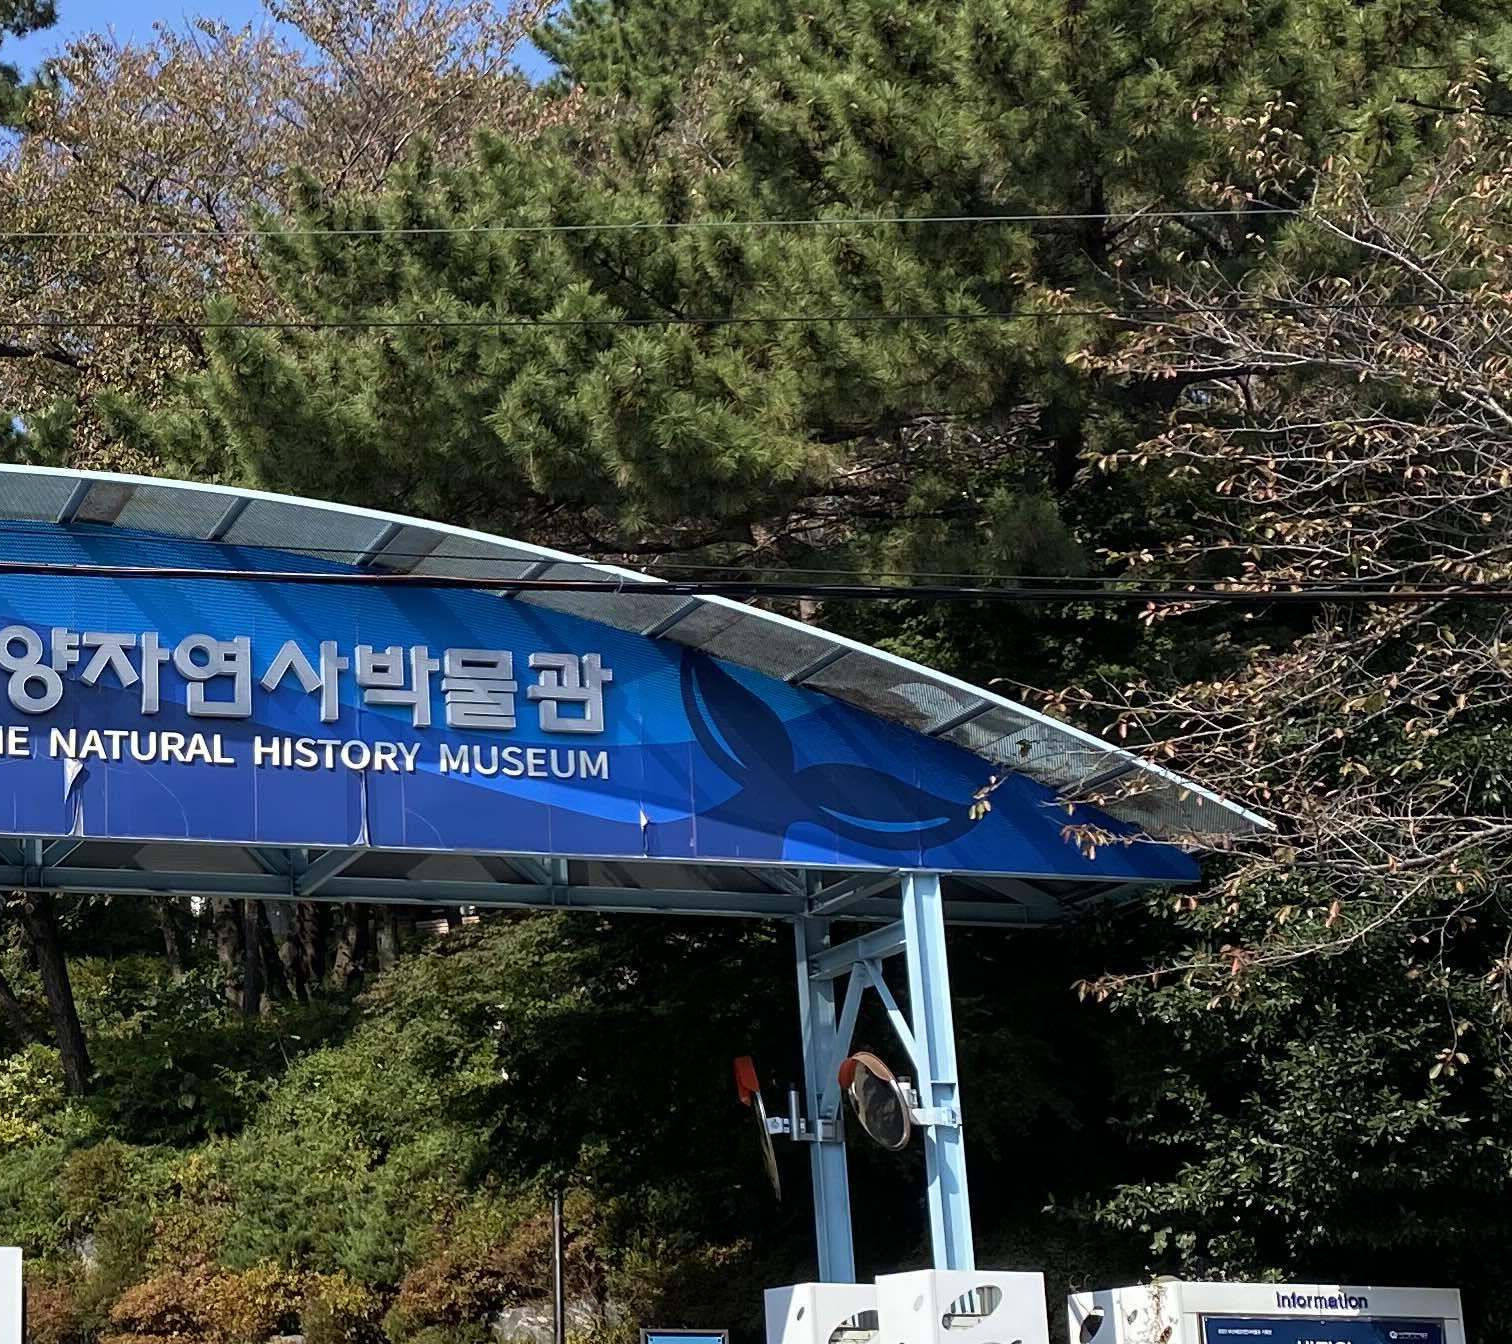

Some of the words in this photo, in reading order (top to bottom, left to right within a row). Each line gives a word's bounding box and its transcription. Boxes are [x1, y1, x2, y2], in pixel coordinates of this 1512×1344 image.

[49, 728, 235, 765] NATURAL
[254, 735, 421, 773] HISTORY
[439, 743, 609, 780] MUSEUM
[1276, 1291, 1368, 1309] Information
